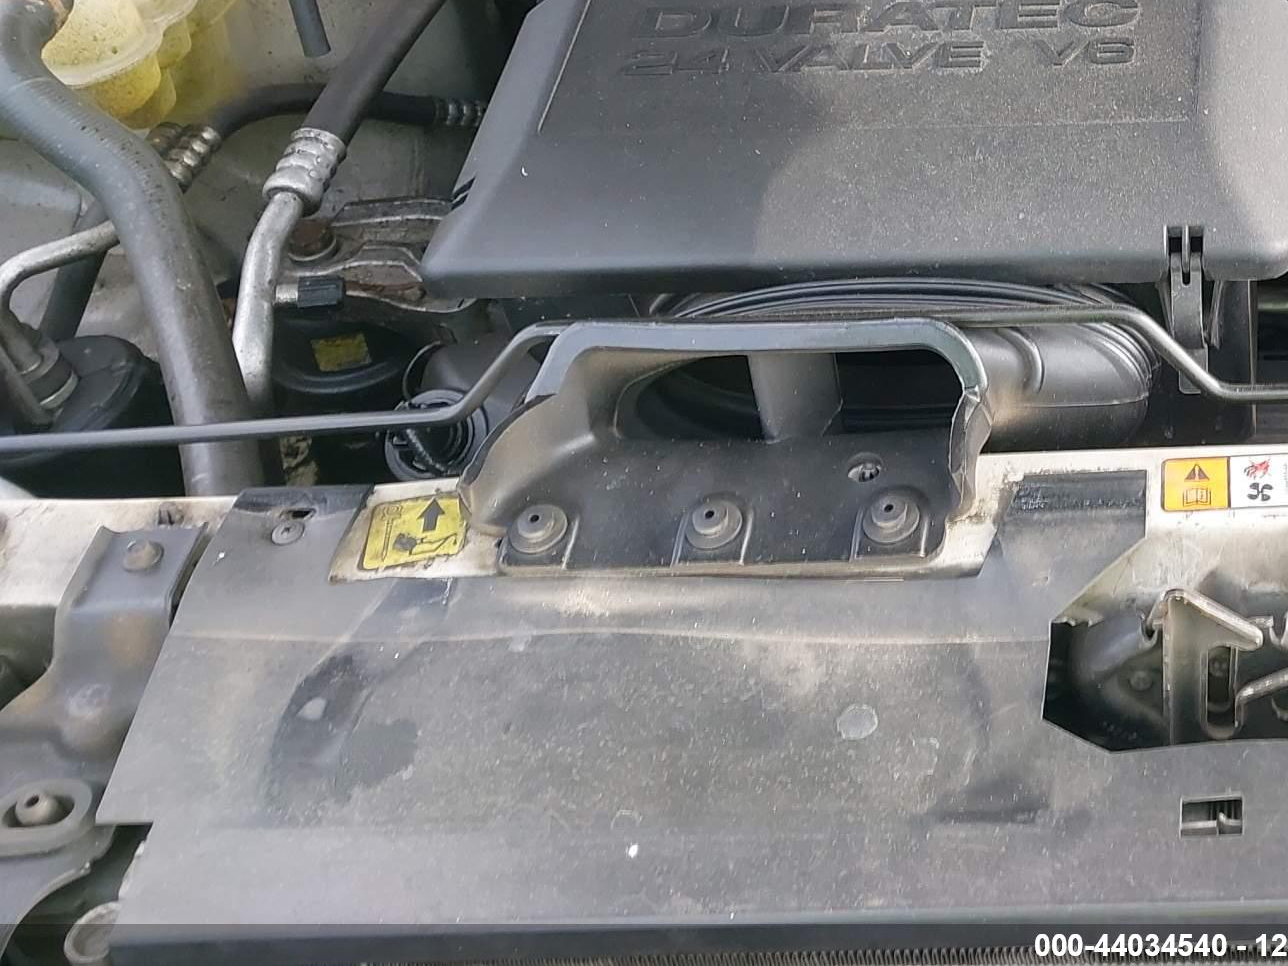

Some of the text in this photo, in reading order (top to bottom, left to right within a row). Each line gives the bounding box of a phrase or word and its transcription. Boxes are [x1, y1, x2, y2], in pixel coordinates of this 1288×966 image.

[620, 37, 1136, 76] 24 VALVE V6
